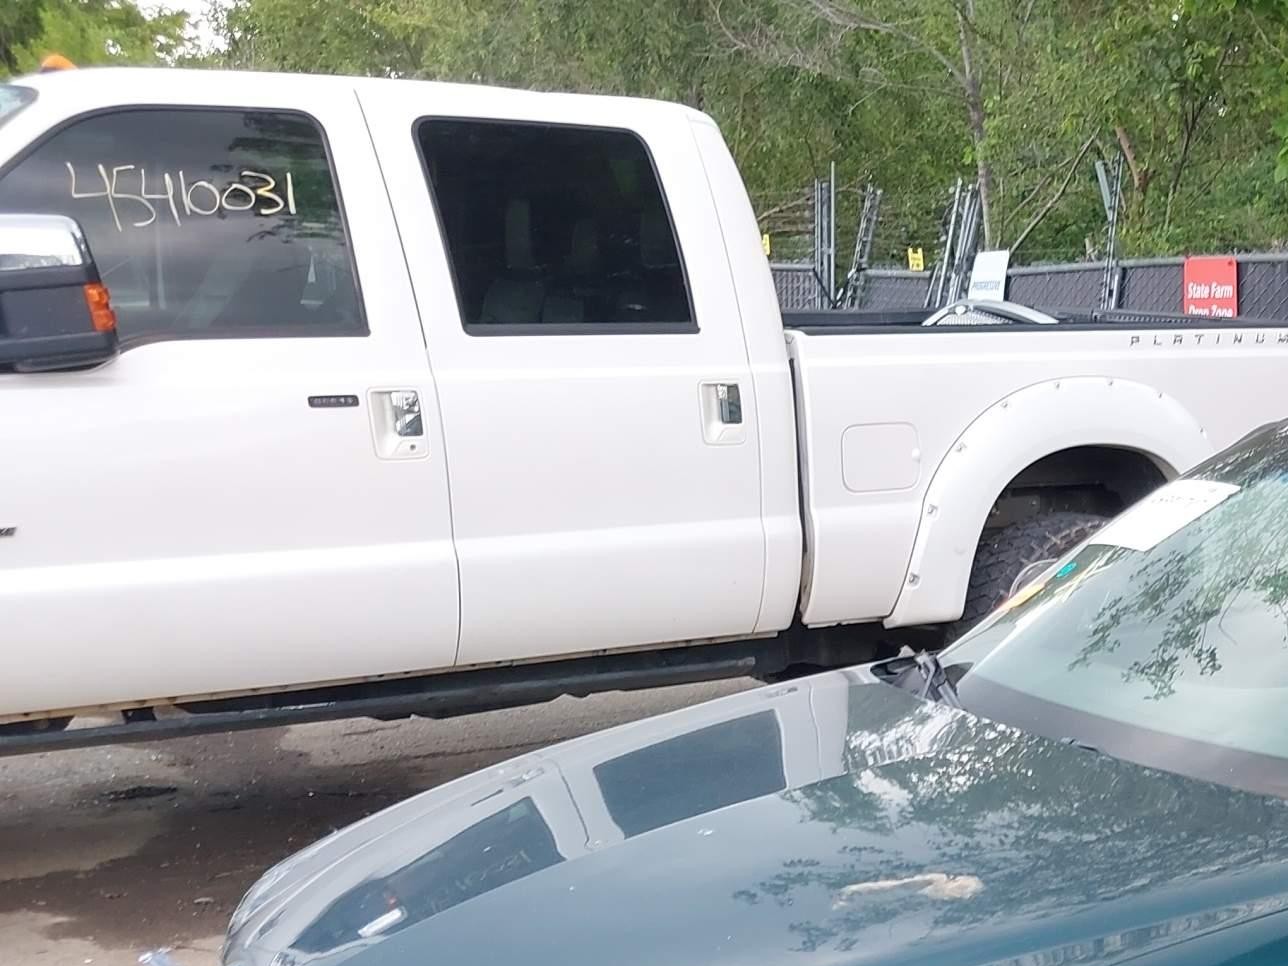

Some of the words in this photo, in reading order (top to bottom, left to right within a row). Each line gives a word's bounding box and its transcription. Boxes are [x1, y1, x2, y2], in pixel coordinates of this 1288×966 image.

[66, 161, 297, 232] 45410031
[1187, 281, 1210, 299] State
[1210, 281, 1233, 299] Farm
